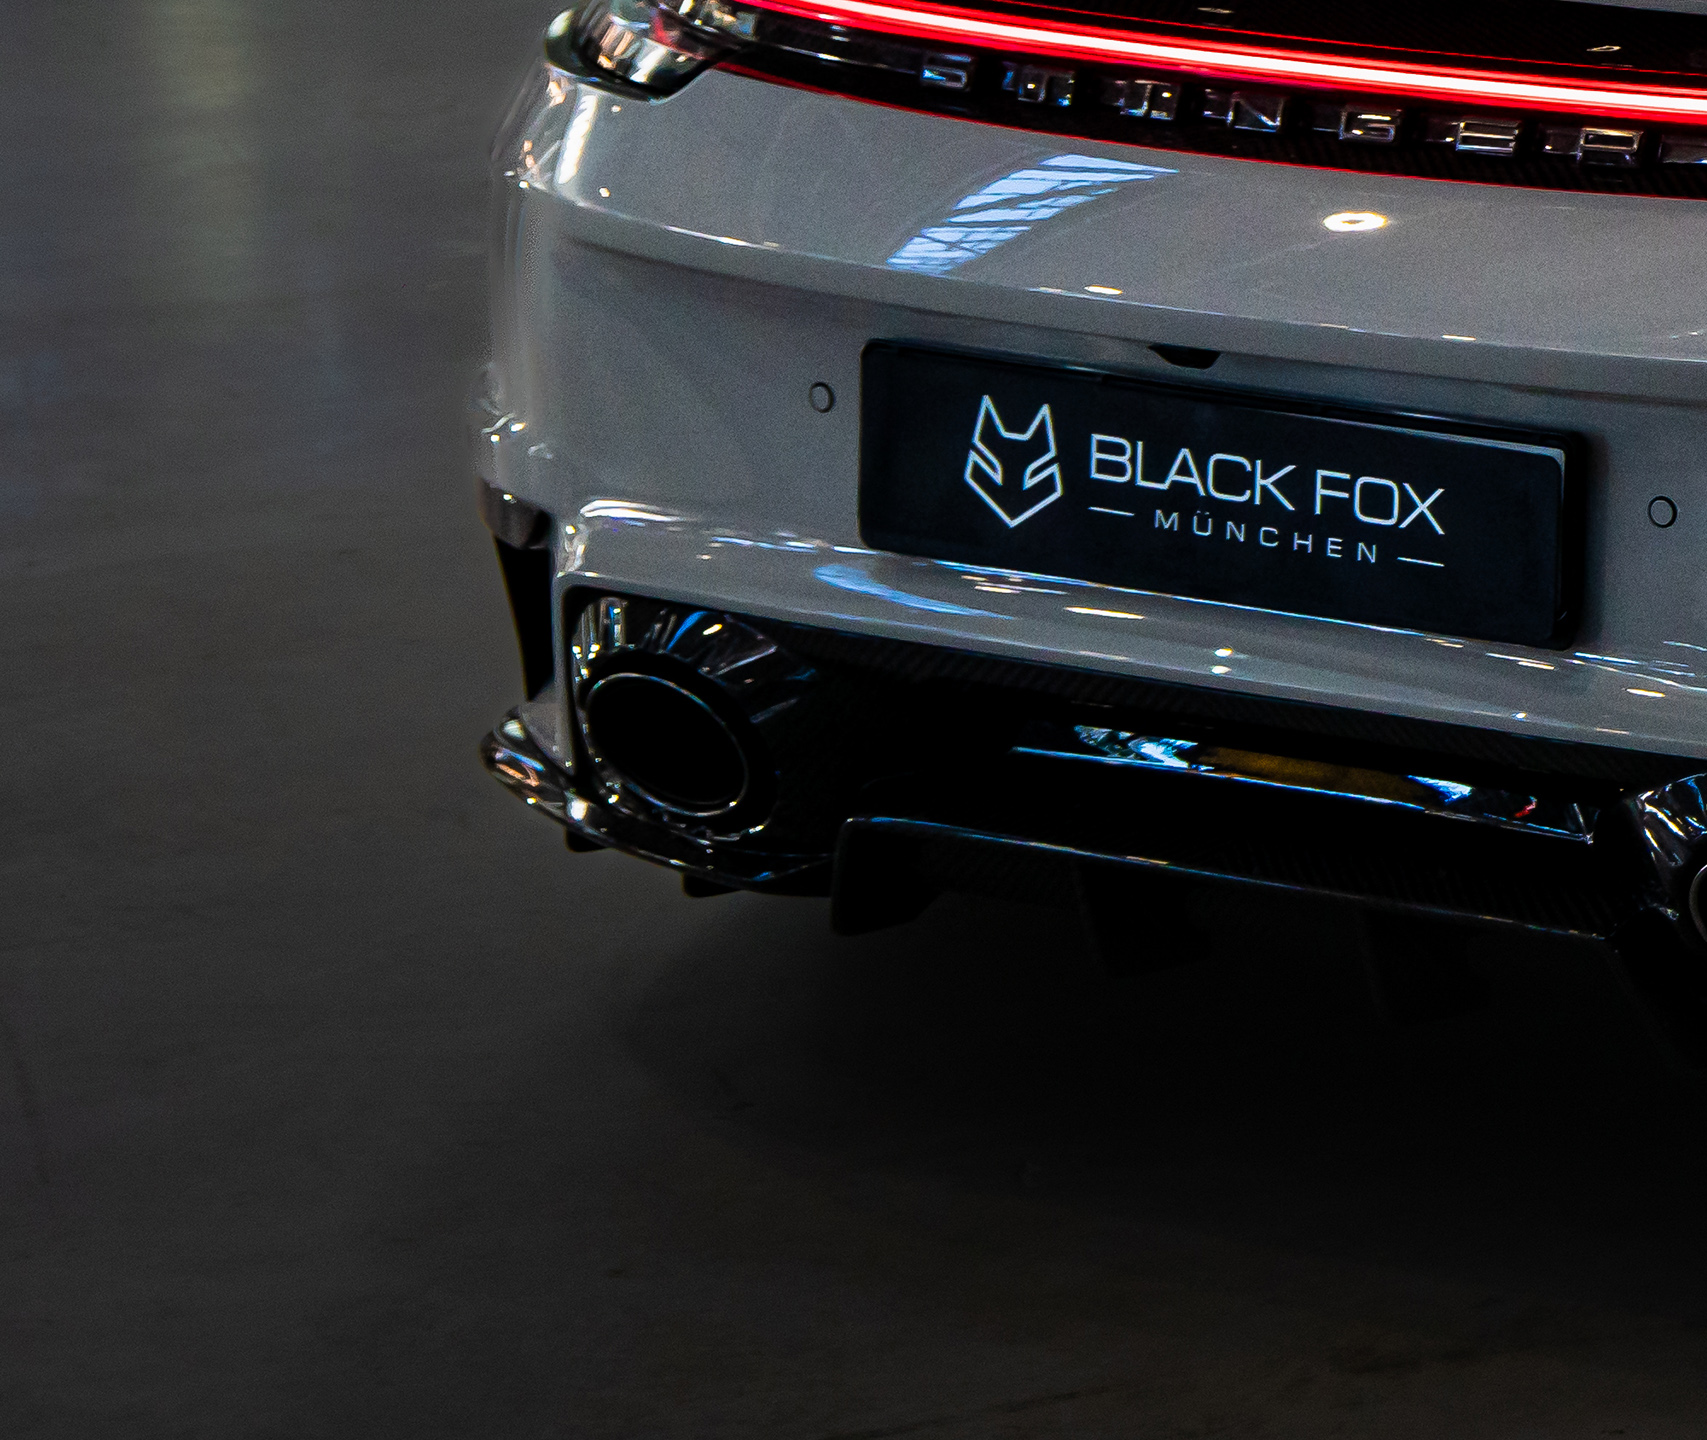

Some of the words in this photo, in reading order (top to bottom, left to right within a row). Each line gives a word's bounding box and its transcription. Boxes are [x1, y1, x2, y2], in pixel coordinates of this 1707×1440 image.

[920, 52, 1645, 166] STINGER
[1089, 433, 1297, 511] BLACK
[1314, 469, 1446, 535] FOX
[1154, 509, 1378, 564] MÜNCHEN
